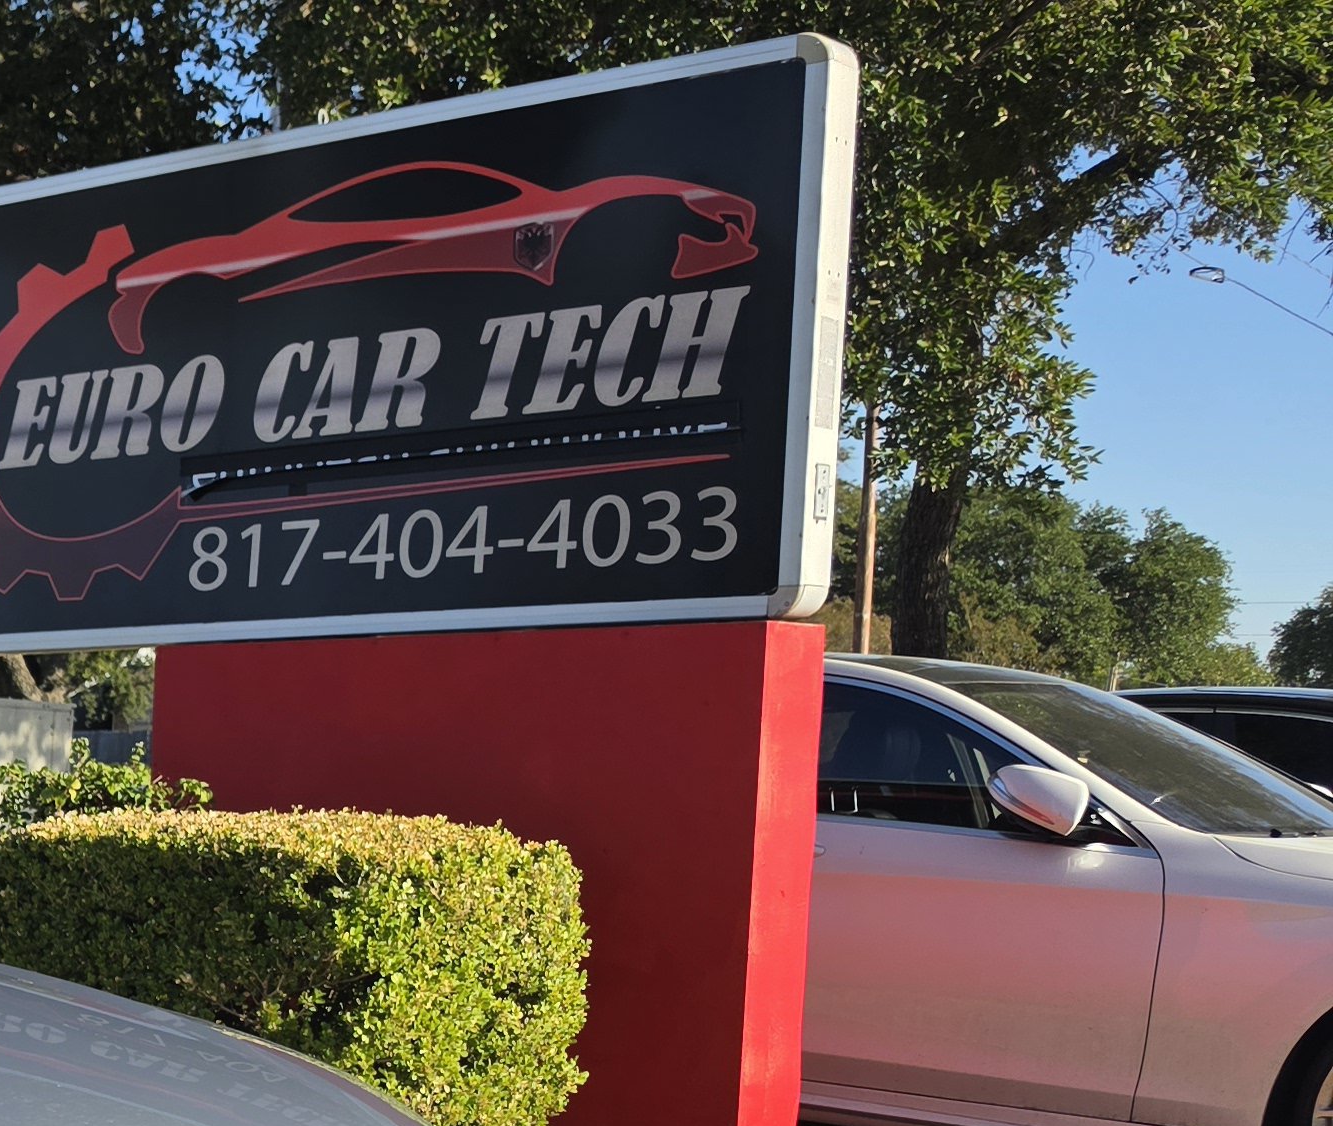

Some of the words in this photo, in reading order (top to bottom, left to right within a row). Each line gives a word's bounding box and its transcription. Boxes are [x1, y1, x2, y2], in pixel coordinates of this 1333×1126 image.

[253, 327, 441, 443] CAR
[470, 285, 751, 420] TECH
[187, 485, 738, 592] 817-404-4033
